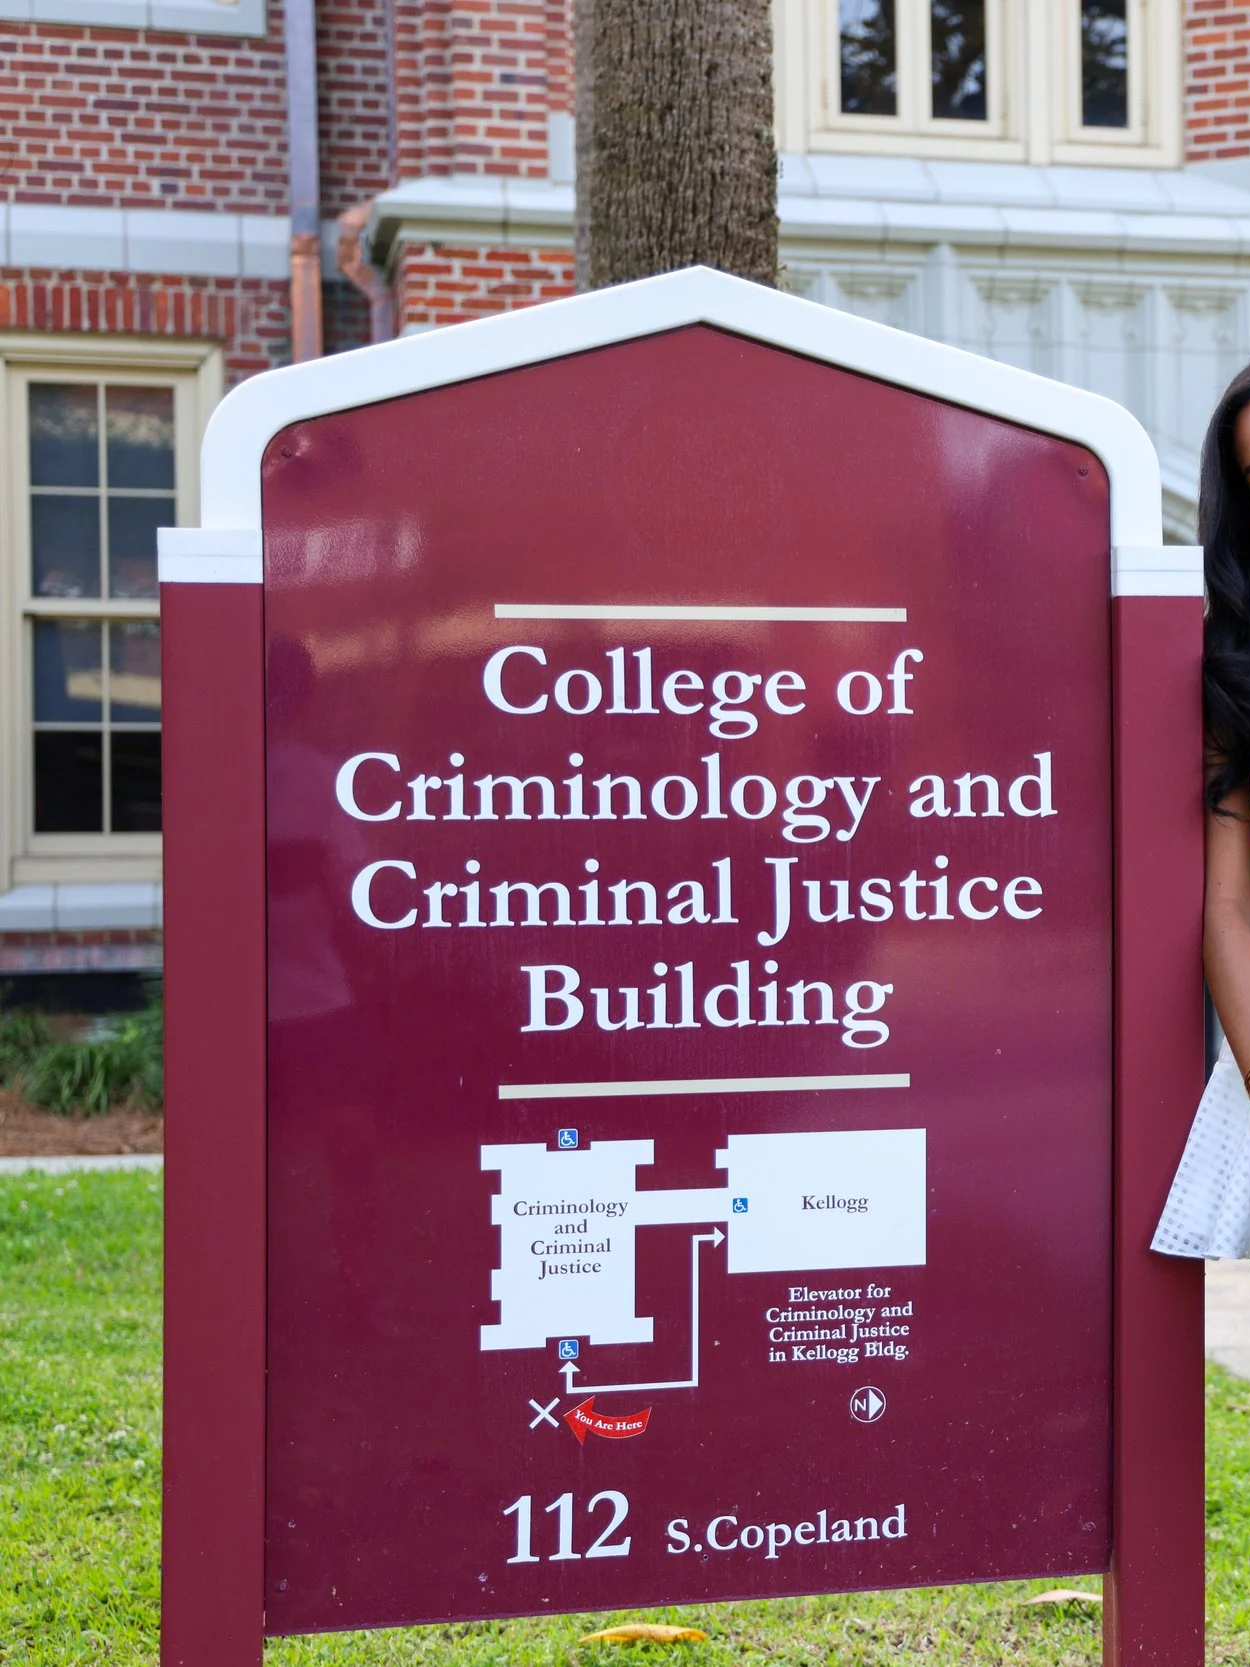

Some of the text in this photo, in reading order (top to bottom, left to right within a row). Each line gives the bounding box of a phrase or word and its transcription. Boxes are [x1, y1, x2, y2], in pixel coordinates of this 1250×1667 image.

[484, 646, 924, 739] College of
[335, 752, 1057, 844] Criminology and
[351, 855, 1043, 947] Criminal Justice
[520, 960, 894, 1049] Building
[513, 1198, 628, 1217] Criminology
[801, 1194, 869, 1214] Kellogg
[554, 1218, 588, 1234] and
[530, 1238, 611, 1255] Criminal
[538, 1259, 602, 1280] Justice
[788, 1283, 892, 1302] Elevator for
[765, 1301, 914, 1324] Criminology and
[769, 1322, 910, 1343] Criminal Justice
[769, 1341, 910, 1363] in Kellogg Bldg.
[854, 1399, 867, 1412] N
[574, 1409, 643, 1430] You Are Here
[504, 1490, 632, 1564] 112
